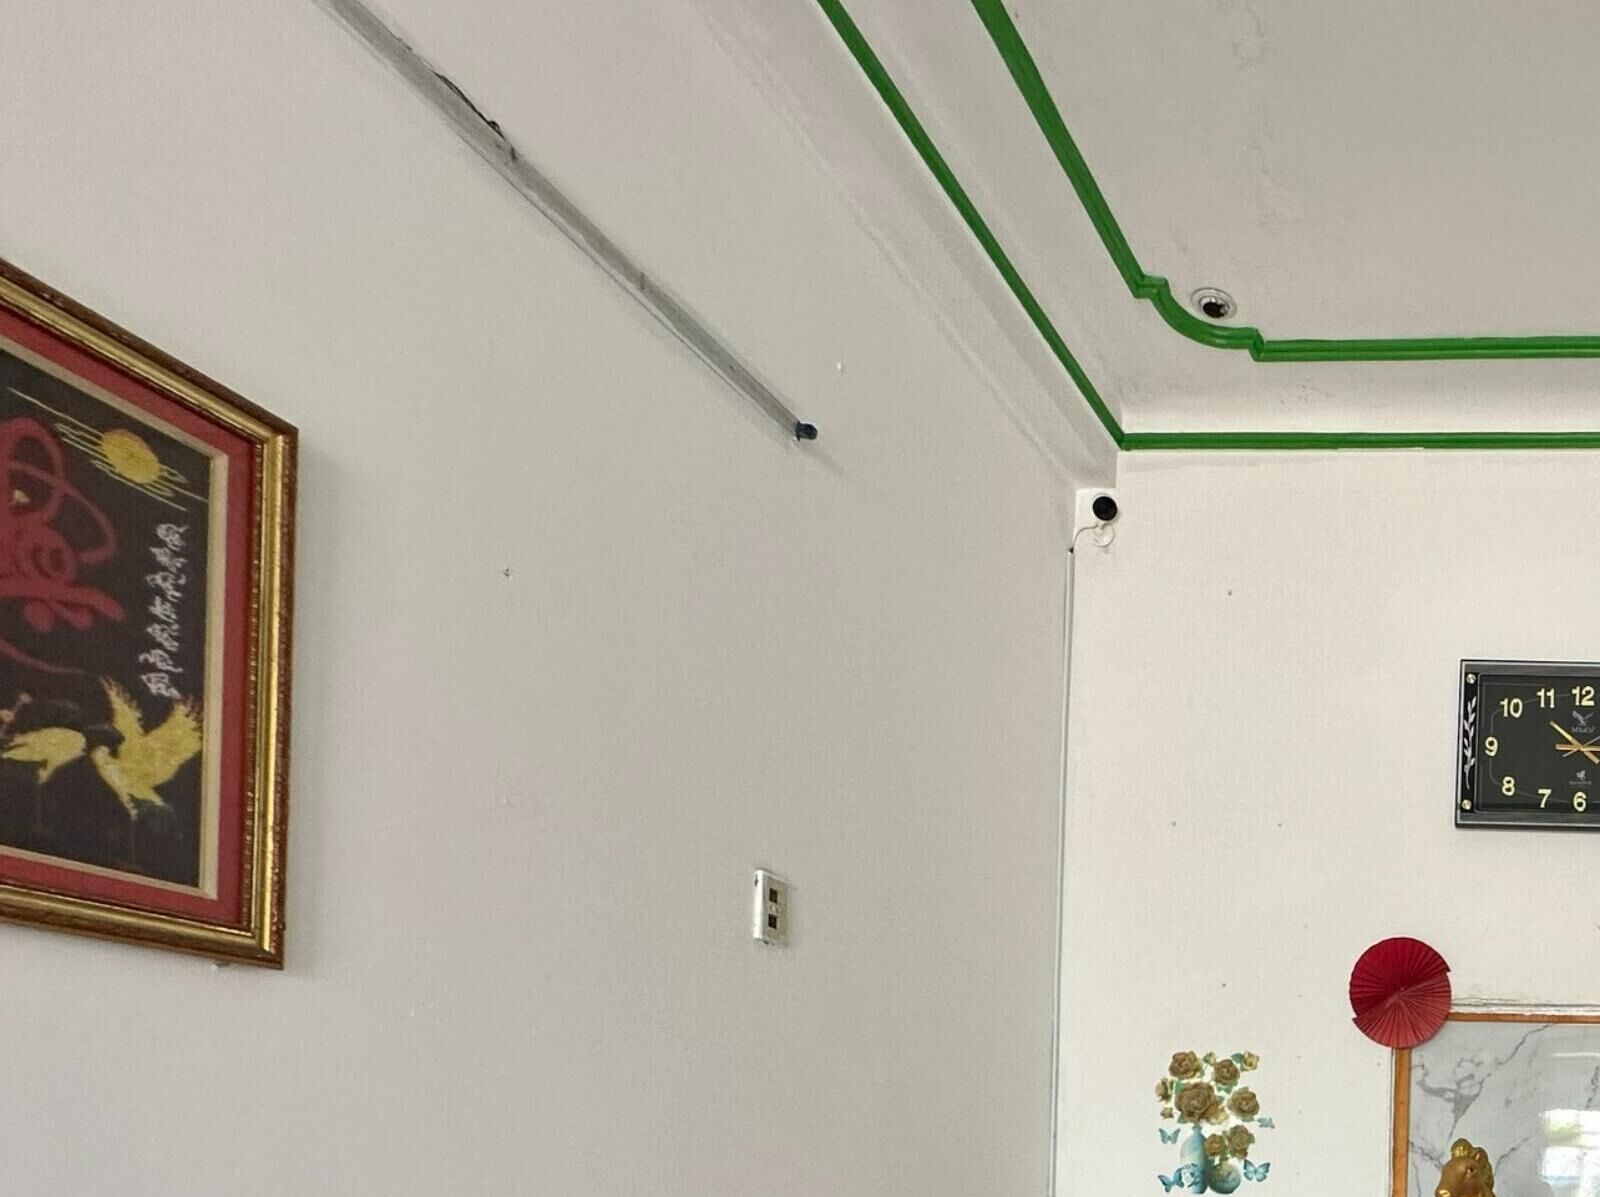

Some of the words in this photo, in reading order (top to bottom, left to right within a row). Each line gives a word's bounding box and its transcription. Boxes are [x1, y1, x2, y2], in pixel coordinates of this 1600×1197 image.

[1537, 688, 1555, 708] 11
[1572, 686, 1595, 706] 12
[1500, 698, 1522, 718] 10
[1485, 737, 1499, 756] 9
[1502, 777, 1515, 796] 8
[1538, 789, 1552, 808] 7
[1573, 792, 1587, 812] 6
